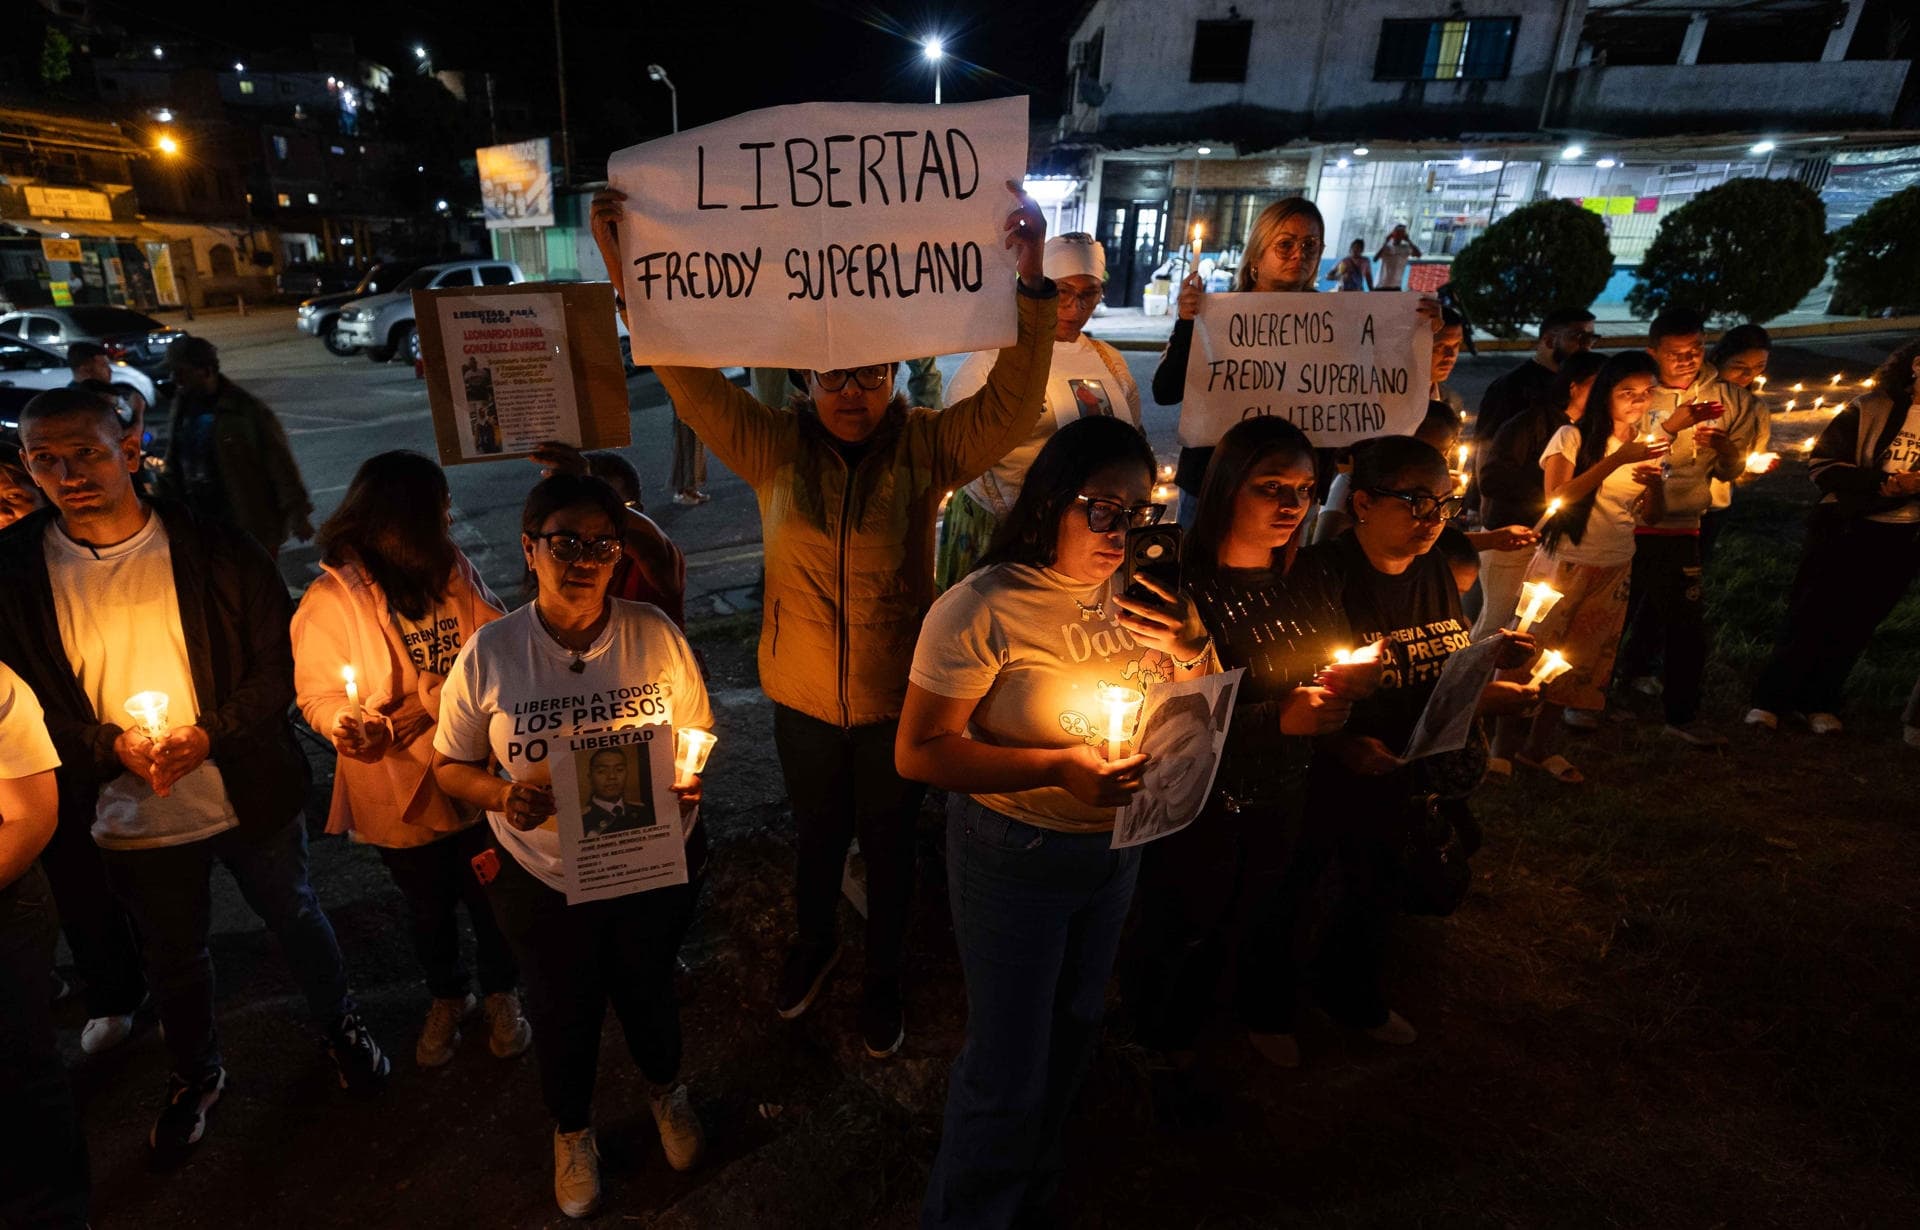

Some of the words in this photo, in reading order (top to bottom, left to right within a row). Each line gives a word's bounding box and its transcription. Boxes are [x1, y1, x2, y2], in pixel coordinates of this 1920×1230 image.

[698, 128, 979, 211] LIBERTAD
[634, 246, 762, 300] FREDDY
[785, 241, 983, 301] SUPERLANO
[453, 310, 504, 319] LIBERTAD
[1229, 310, 1334, 348] QUEREMOS
[1361, 314, 1375, 345] A
[464, 329, 512, 340] LEONARDO
[513, 327, 544, 338] RAFAEL
[1207, 359, 1287, 392] FREDDY
[1297, 363, 1408, 395] SUPERLANO
[404, 627, 435, 647] EREN
[1061, 621, 1134, 664] Dai
[513, 711, 562, 736] LOS
[572, 697, 666, 726] PRESOS
[514, 694, 585, 715] LIBEREN
[590, 692, 604, 705] A
[606, 682, 661, 700] TODOS
[570, 730, 654, 751] LIBERTAD
